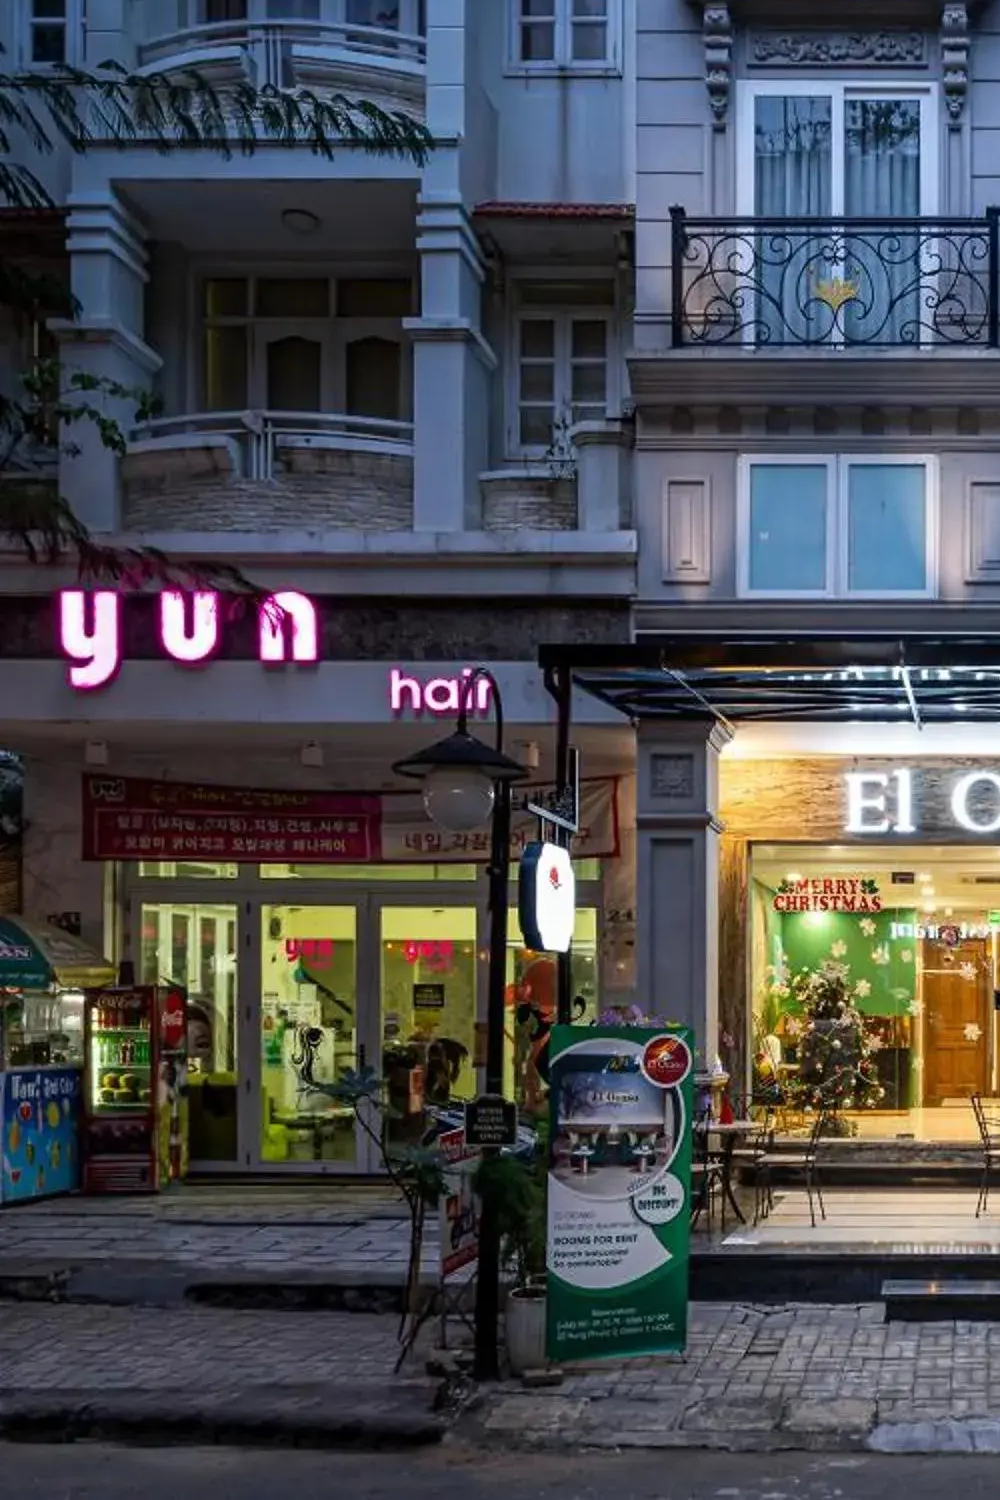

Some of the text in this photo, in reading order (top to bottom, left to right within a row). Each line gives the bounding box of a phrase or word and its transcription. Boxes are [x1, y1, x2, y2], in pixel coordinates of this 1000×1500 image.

[60, 590, 318, 688] yun
[389, 668, 493, 710] hair
[843, 767, 917, 833] El
[794, 879, 861, 895] MERRY
[772, 895, 882, 912] CHRISTMAS
[554, 1234, 639, 1246] ROOMS FOR RENT
